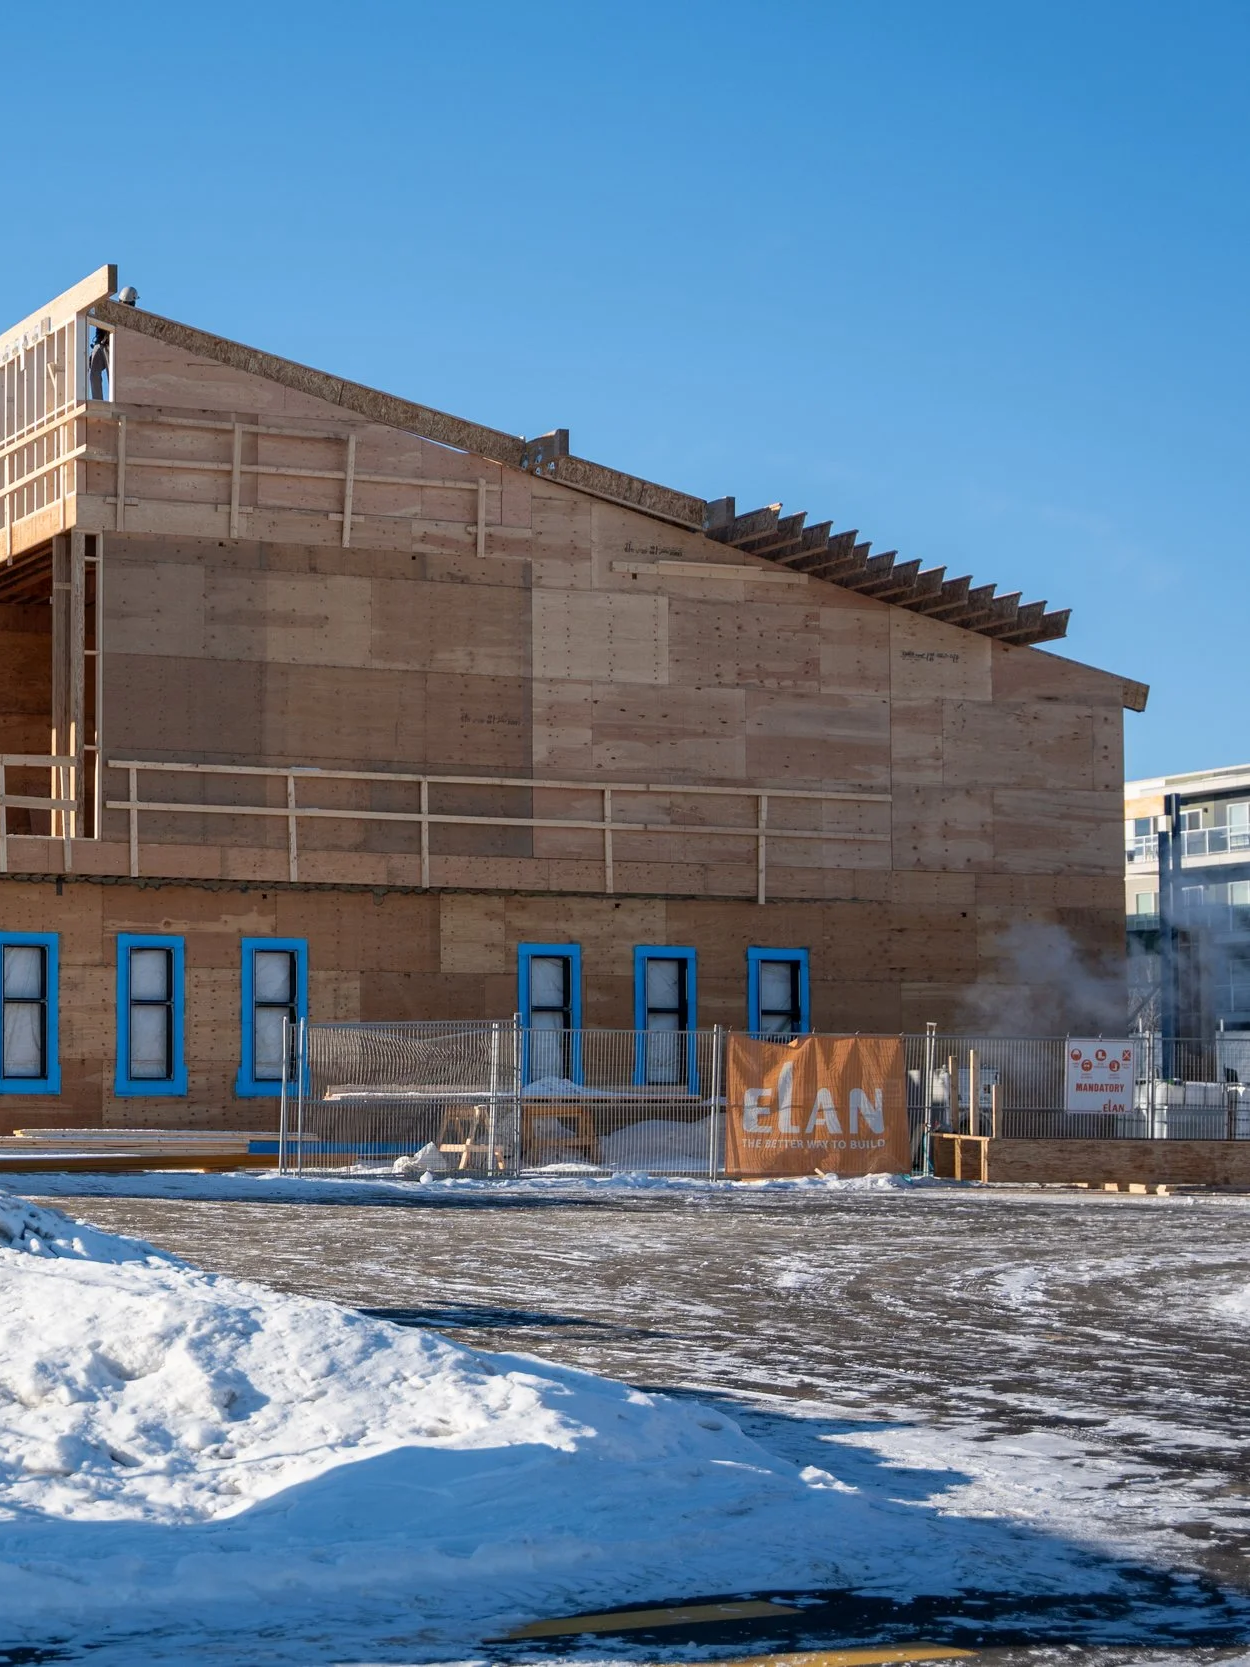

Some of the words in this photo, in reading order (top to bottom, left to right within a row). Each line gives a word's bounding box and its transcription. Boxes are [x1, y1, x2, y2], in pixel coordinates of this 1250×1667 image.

[1075, 1083, 1125, 1093] MANDATORY
[742, 1061, 885, 1134] ELAN
[1102, 1099, 1125, 1112] ELAN
[742, 1138, 761, 1149] THE
[764, 1138, 803, 1149] BETTER
[806, 1139, 828, 1149] WAY
[833, 1139, 847, 1149] TO
[850, 1138, 886, 1149] BUILD
